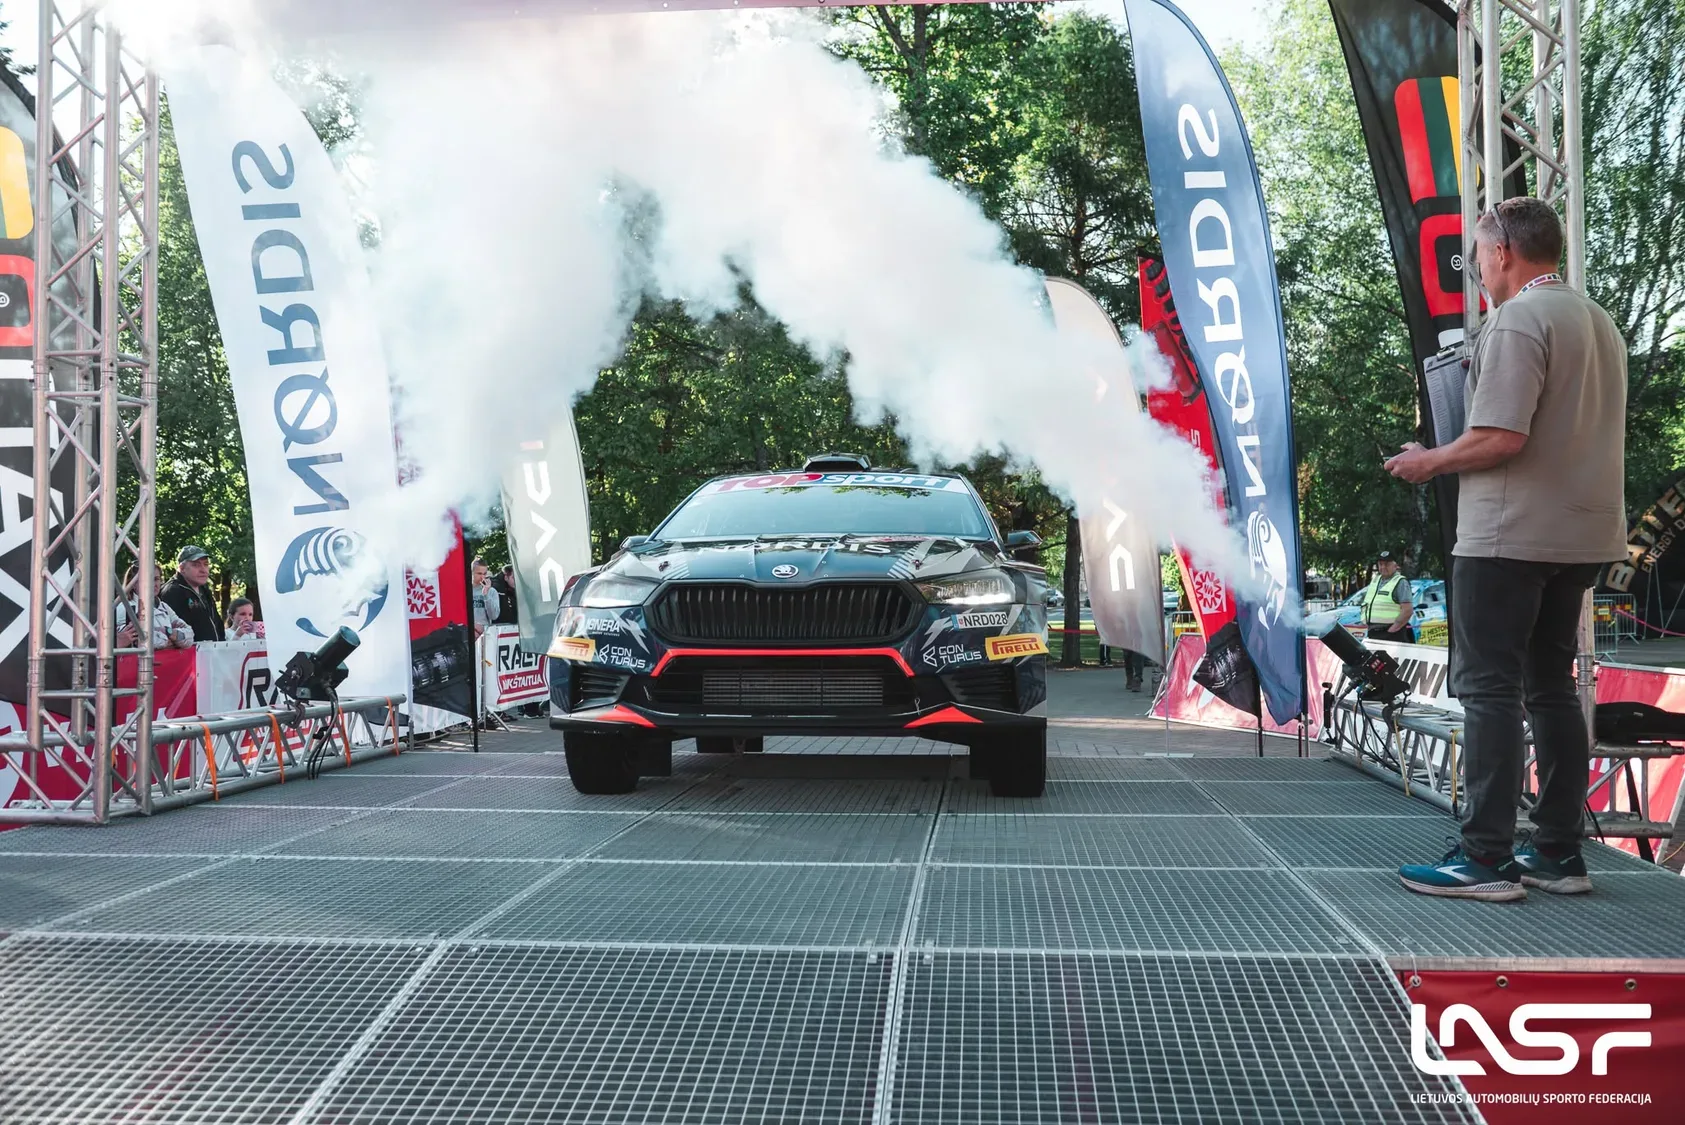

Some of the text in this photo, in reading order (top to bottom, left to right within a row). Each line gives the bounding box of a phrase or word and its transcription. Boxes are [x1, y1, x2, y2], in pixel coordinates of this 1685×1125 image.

[1641, 526, 1677, 574] ENERGY
[963, 613, 1009, 627] NRD028
[611, 646, 632, 657] CON
[938, 644, 965, 655] CON
[991, 637, 1041, 656] PIRELLI
[610, 655, 646, 669] TURUS
[940, 651, 983, 664] TURUS
